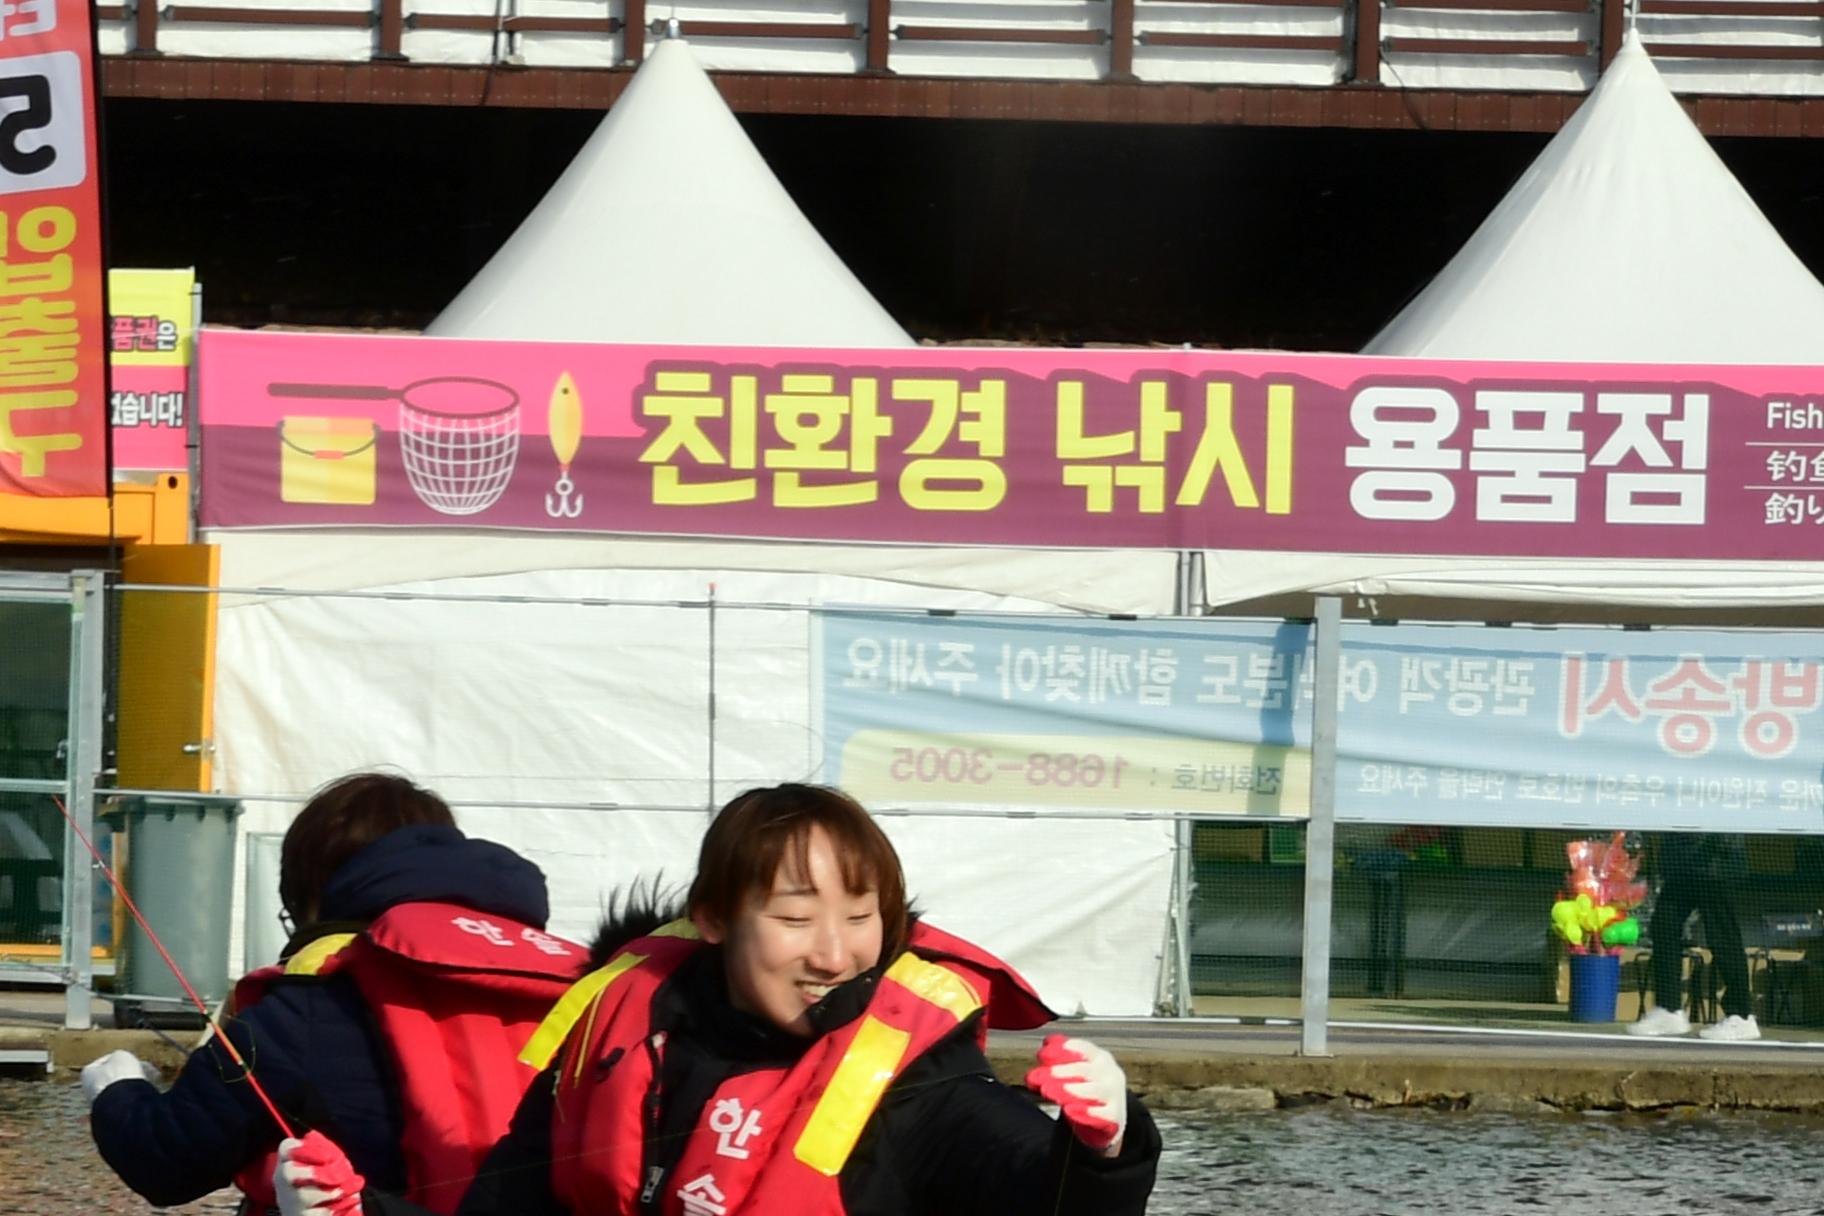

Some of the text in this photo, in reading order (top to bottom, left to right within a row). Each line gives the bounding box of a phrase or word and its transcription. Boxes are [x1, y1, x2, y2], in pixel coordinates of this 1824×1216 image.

[637, 371, 1711, 525] 친환경 낚시 용품점
